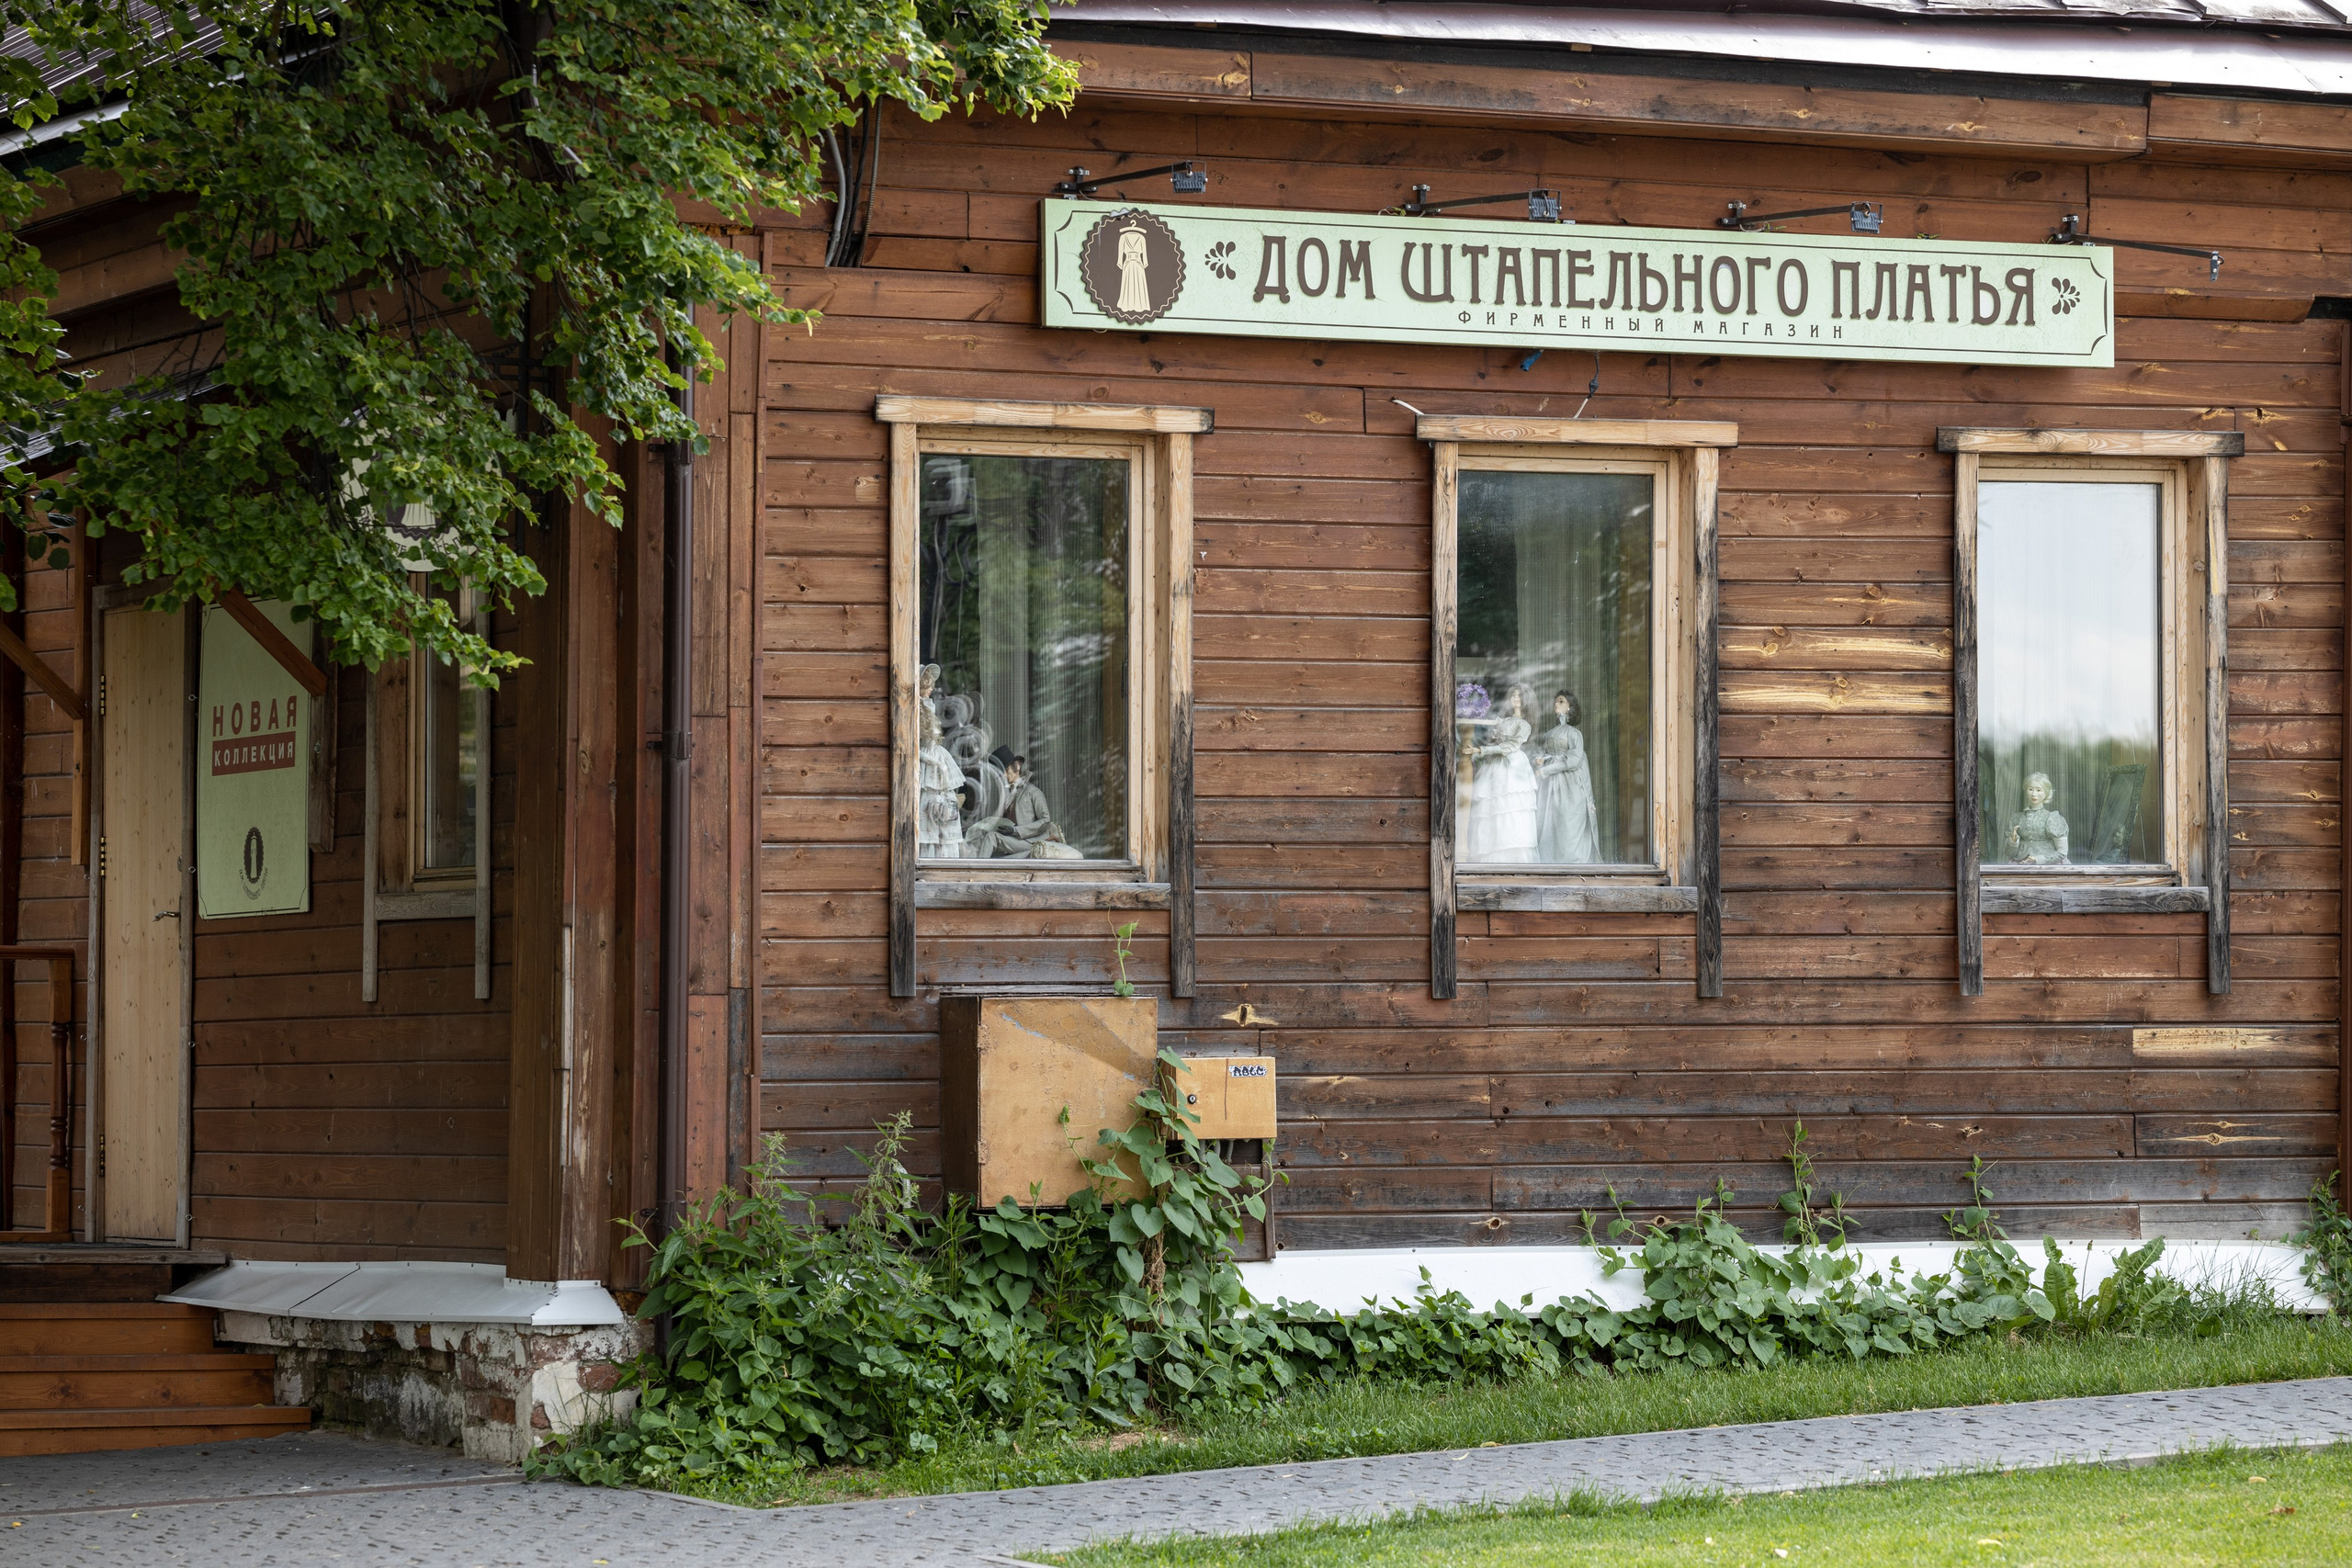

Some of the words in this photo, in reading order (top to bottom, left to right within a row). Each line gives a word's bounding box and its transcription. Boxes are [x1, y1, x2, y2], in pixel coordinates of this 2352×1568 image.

[1252, 234, 1376, 304] ДОМ
[1401, 242, 1808, 317] ШТАПЕЛЬНОГО
[1831, 259, 2036, 327] ПЛАТЬЯ
[1457, 310, 1665, 333] ФИРМЕННЫЙ
[1692, 321, 1843, 339] МАГАЗИН
[212, 695, 297, 737] НОВАЯ
[213, 741, 295, 768] КОЛЛЕКЦИЯ
